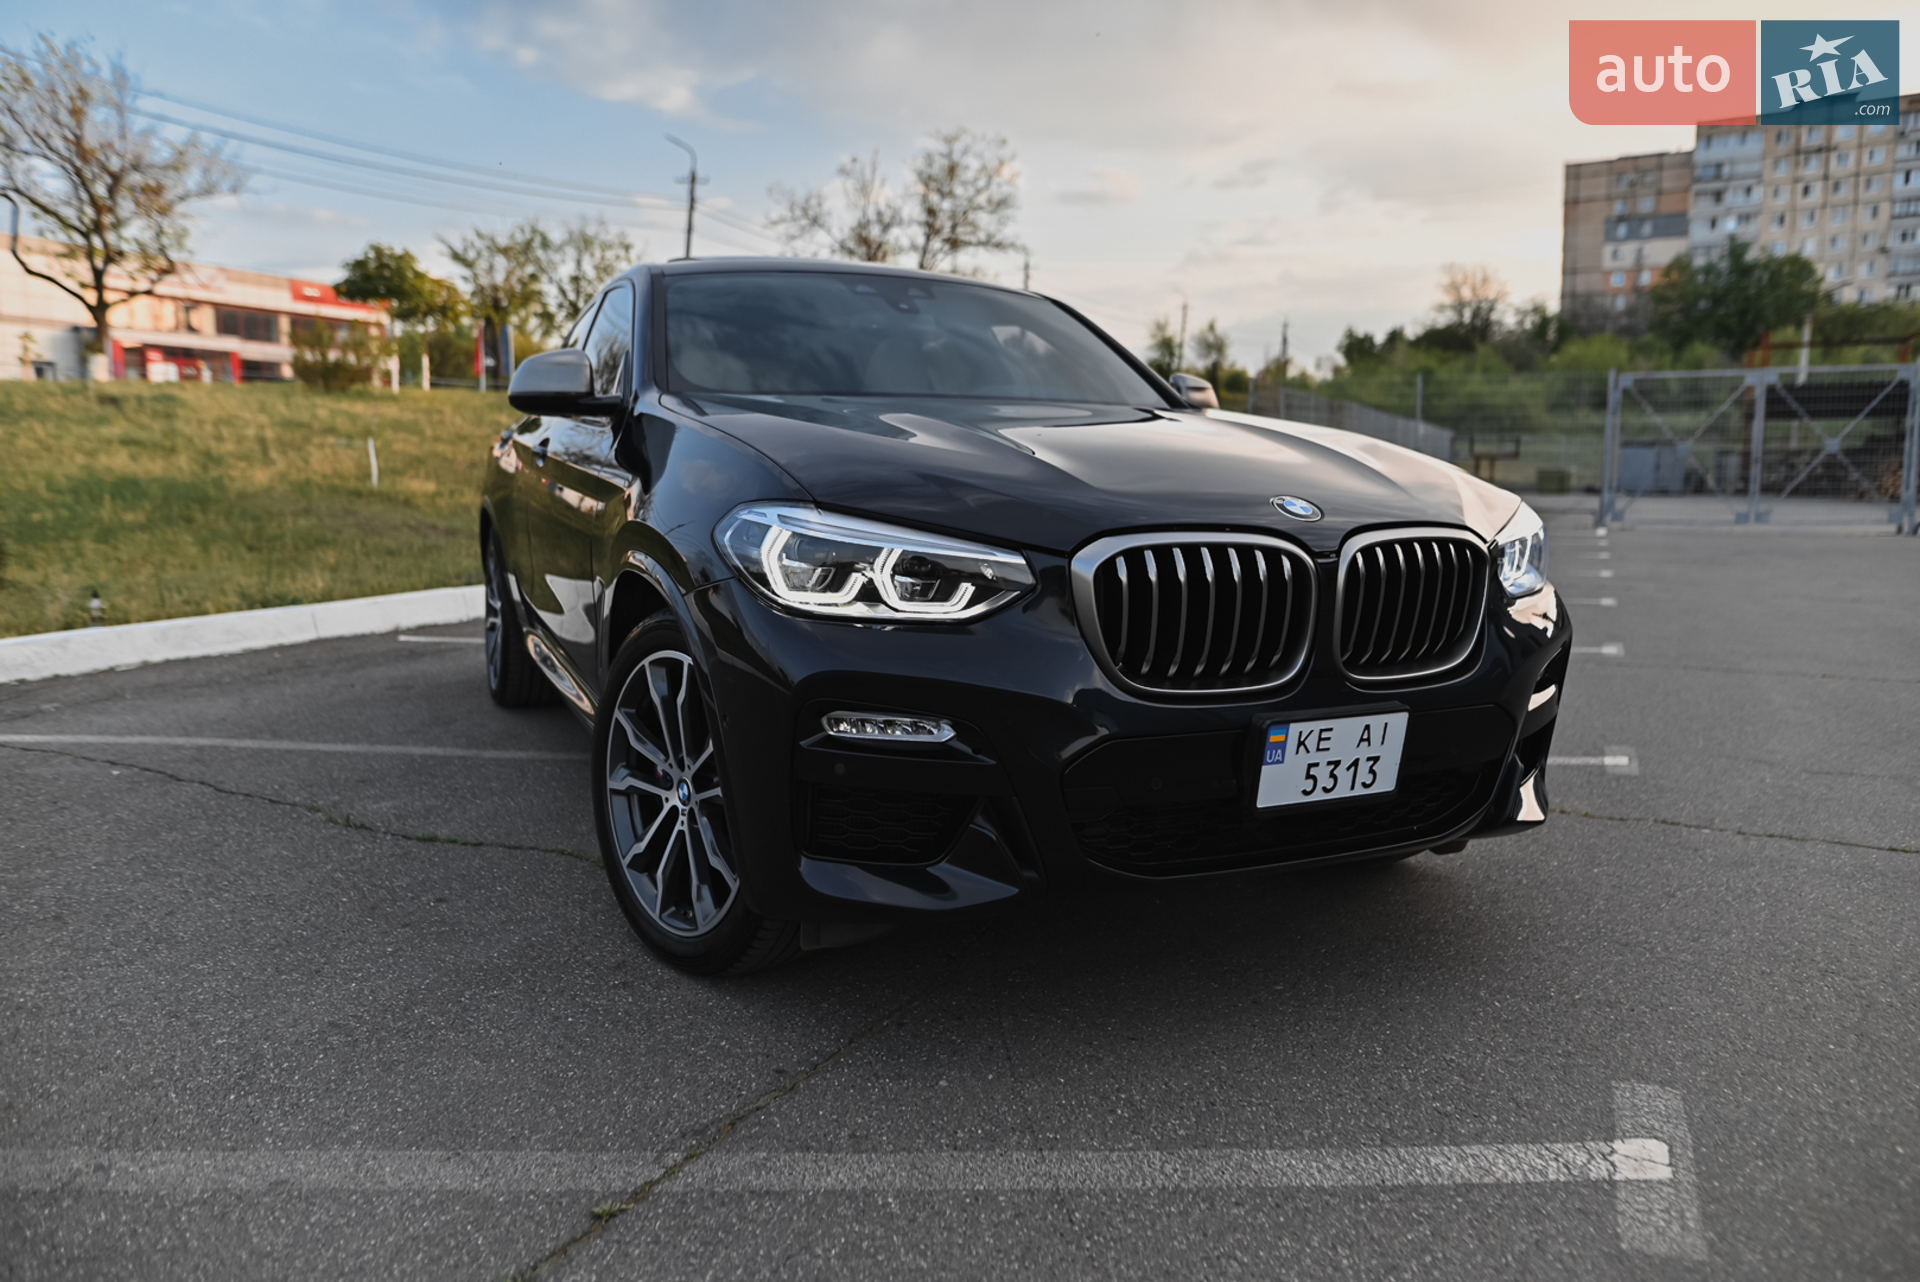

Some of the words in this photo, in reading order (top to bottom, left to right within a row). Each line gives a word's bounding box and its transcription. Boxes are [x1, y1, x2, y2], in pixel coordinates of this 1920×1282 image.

[1295, 727, 1334, 755] KE
[1356, 722, 1388, 748] AI
[1266, 749, 1283, 763] UA
[1301, 755, 1381, 796] 5313
